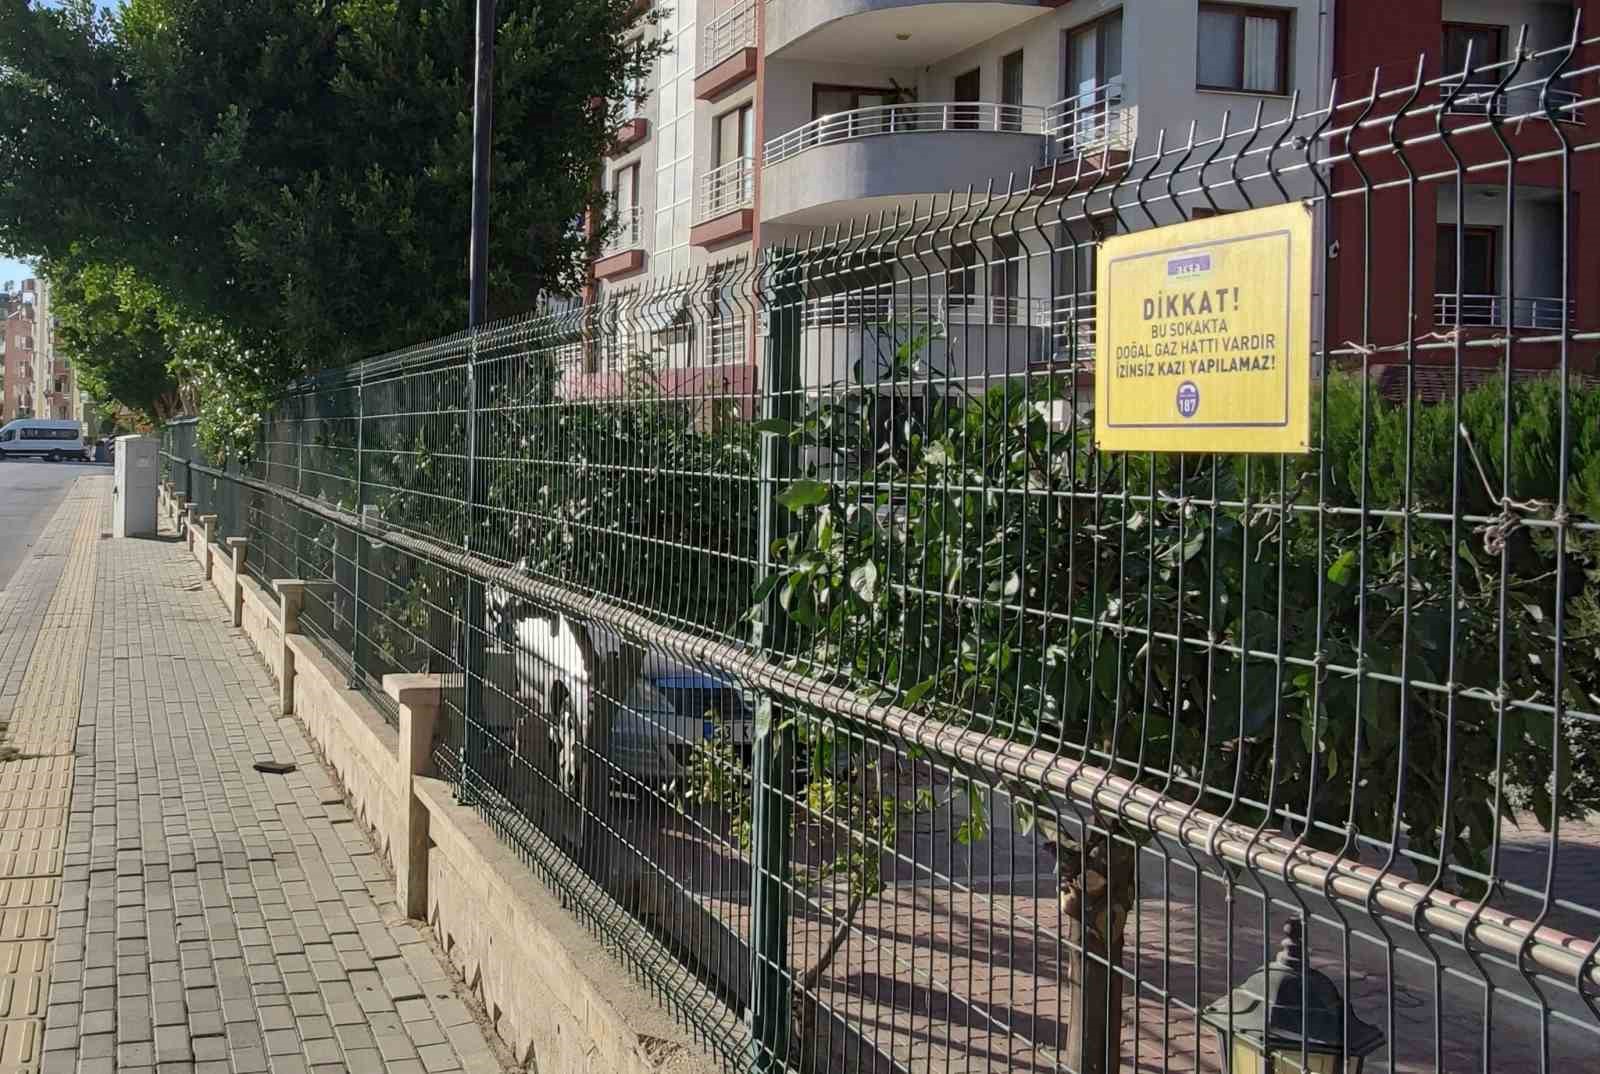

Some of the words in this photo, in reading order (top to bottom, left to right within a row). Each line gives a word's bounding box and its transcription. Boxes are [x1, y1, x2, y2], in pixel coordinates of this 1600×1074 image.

[1144, 287, 1239, 320] DİKKAT!
[1151, 324, 1167, 339] BU
[1170, 319, 1228, 337] SOKAKTA
[1116, 342, 1152, 360] DOĞAL
[1155, 342, 1177, 357] GAZ
[1181, 338, 1218, 355] HATTI
[1223, 334, 1275, 350] VARDIR
[1158, 361, 1185, 376] KAZI
[1190, 355, 1276, 374] YAPILAMAZ!
[1179, 399, 1196, 413] 187
